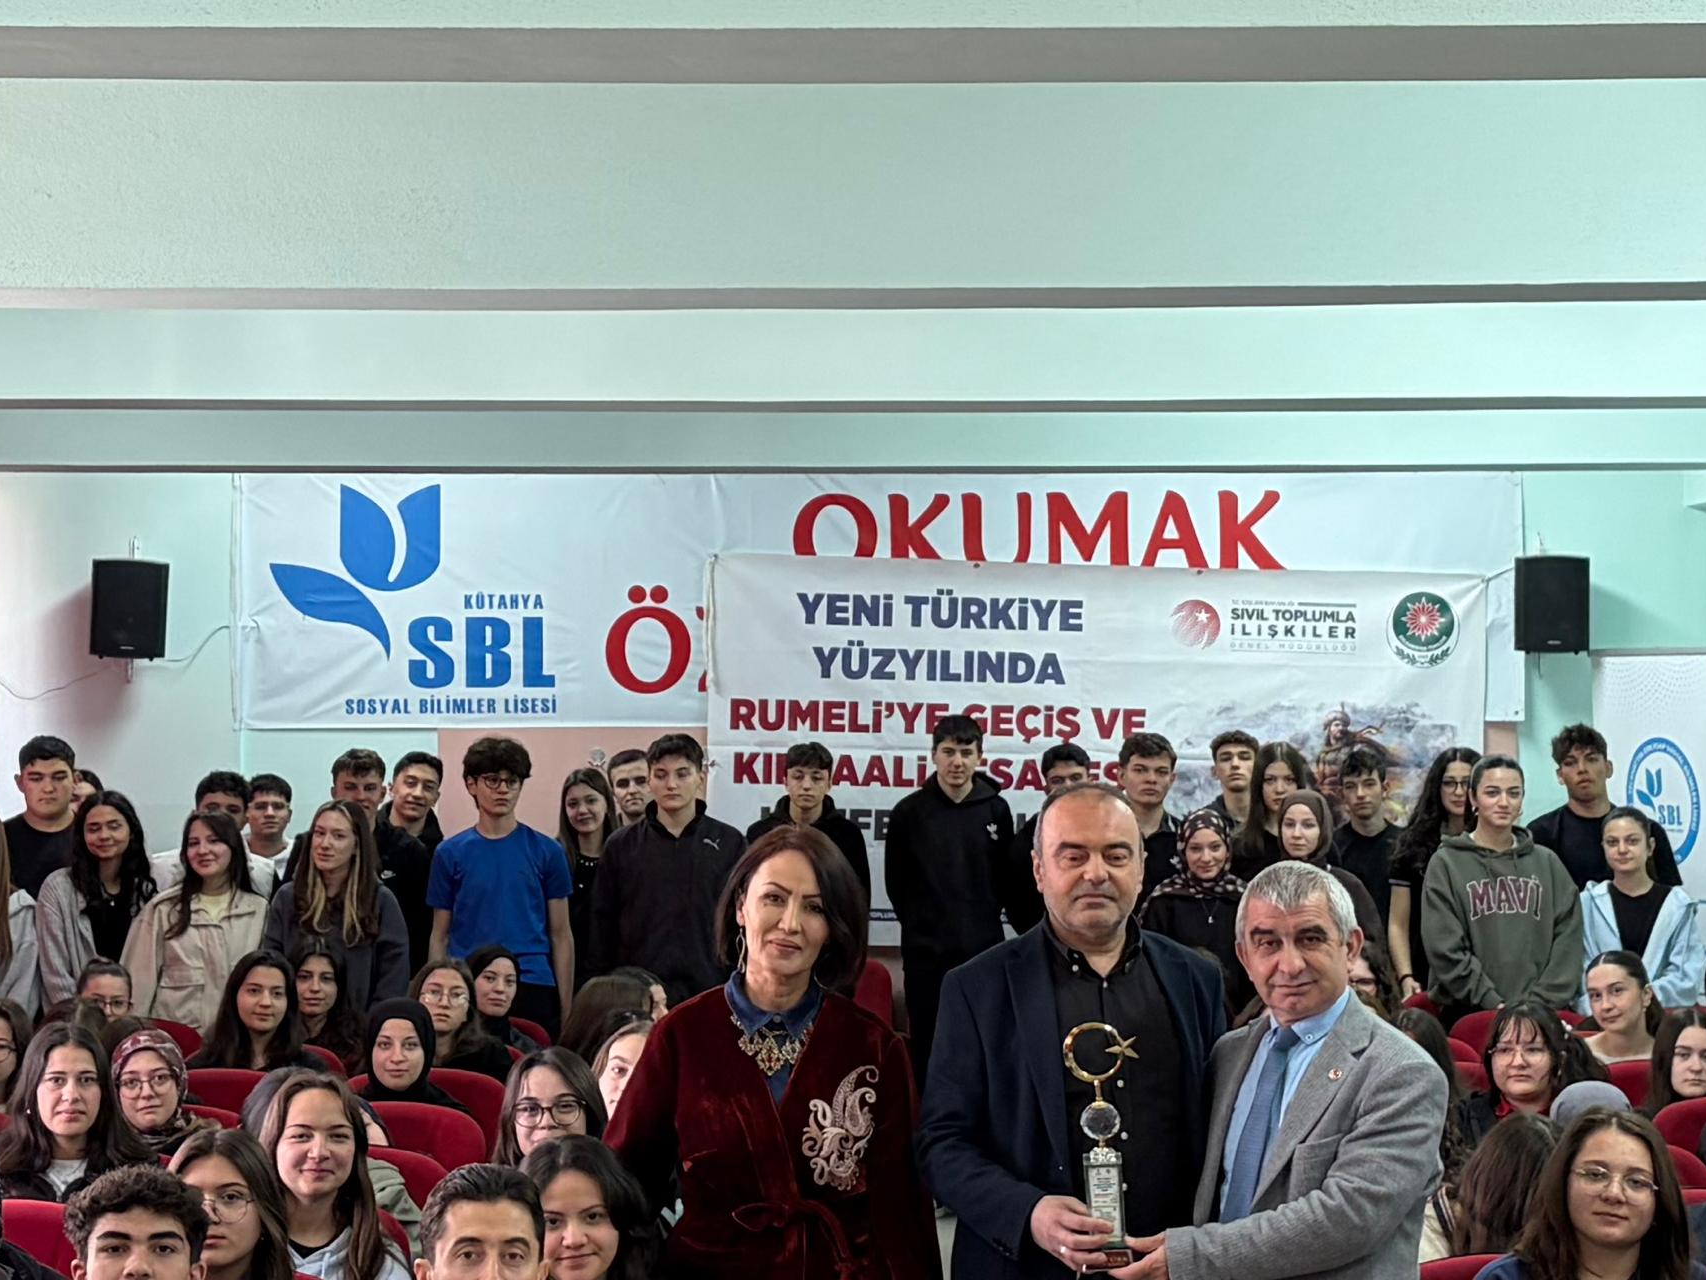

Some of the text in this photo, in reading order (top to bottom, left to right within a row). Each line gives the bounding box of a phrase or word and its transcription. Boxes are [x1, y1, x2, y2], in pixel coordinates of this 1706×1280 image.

[793, 489, 1286, 571] OKUMAK
[463, 592, 544, 610] KÜTAHYA
[1271, 608, 1356, 624] TOPLUMLA
[408, 616, 556, 689] SBL
[812, 640, 1066, 685] YÜZYILINDA
[345, 694, 557, 715] SOSYAL BİLİMLER LİSESİ
[1090, 707, 1147, 740] VE
